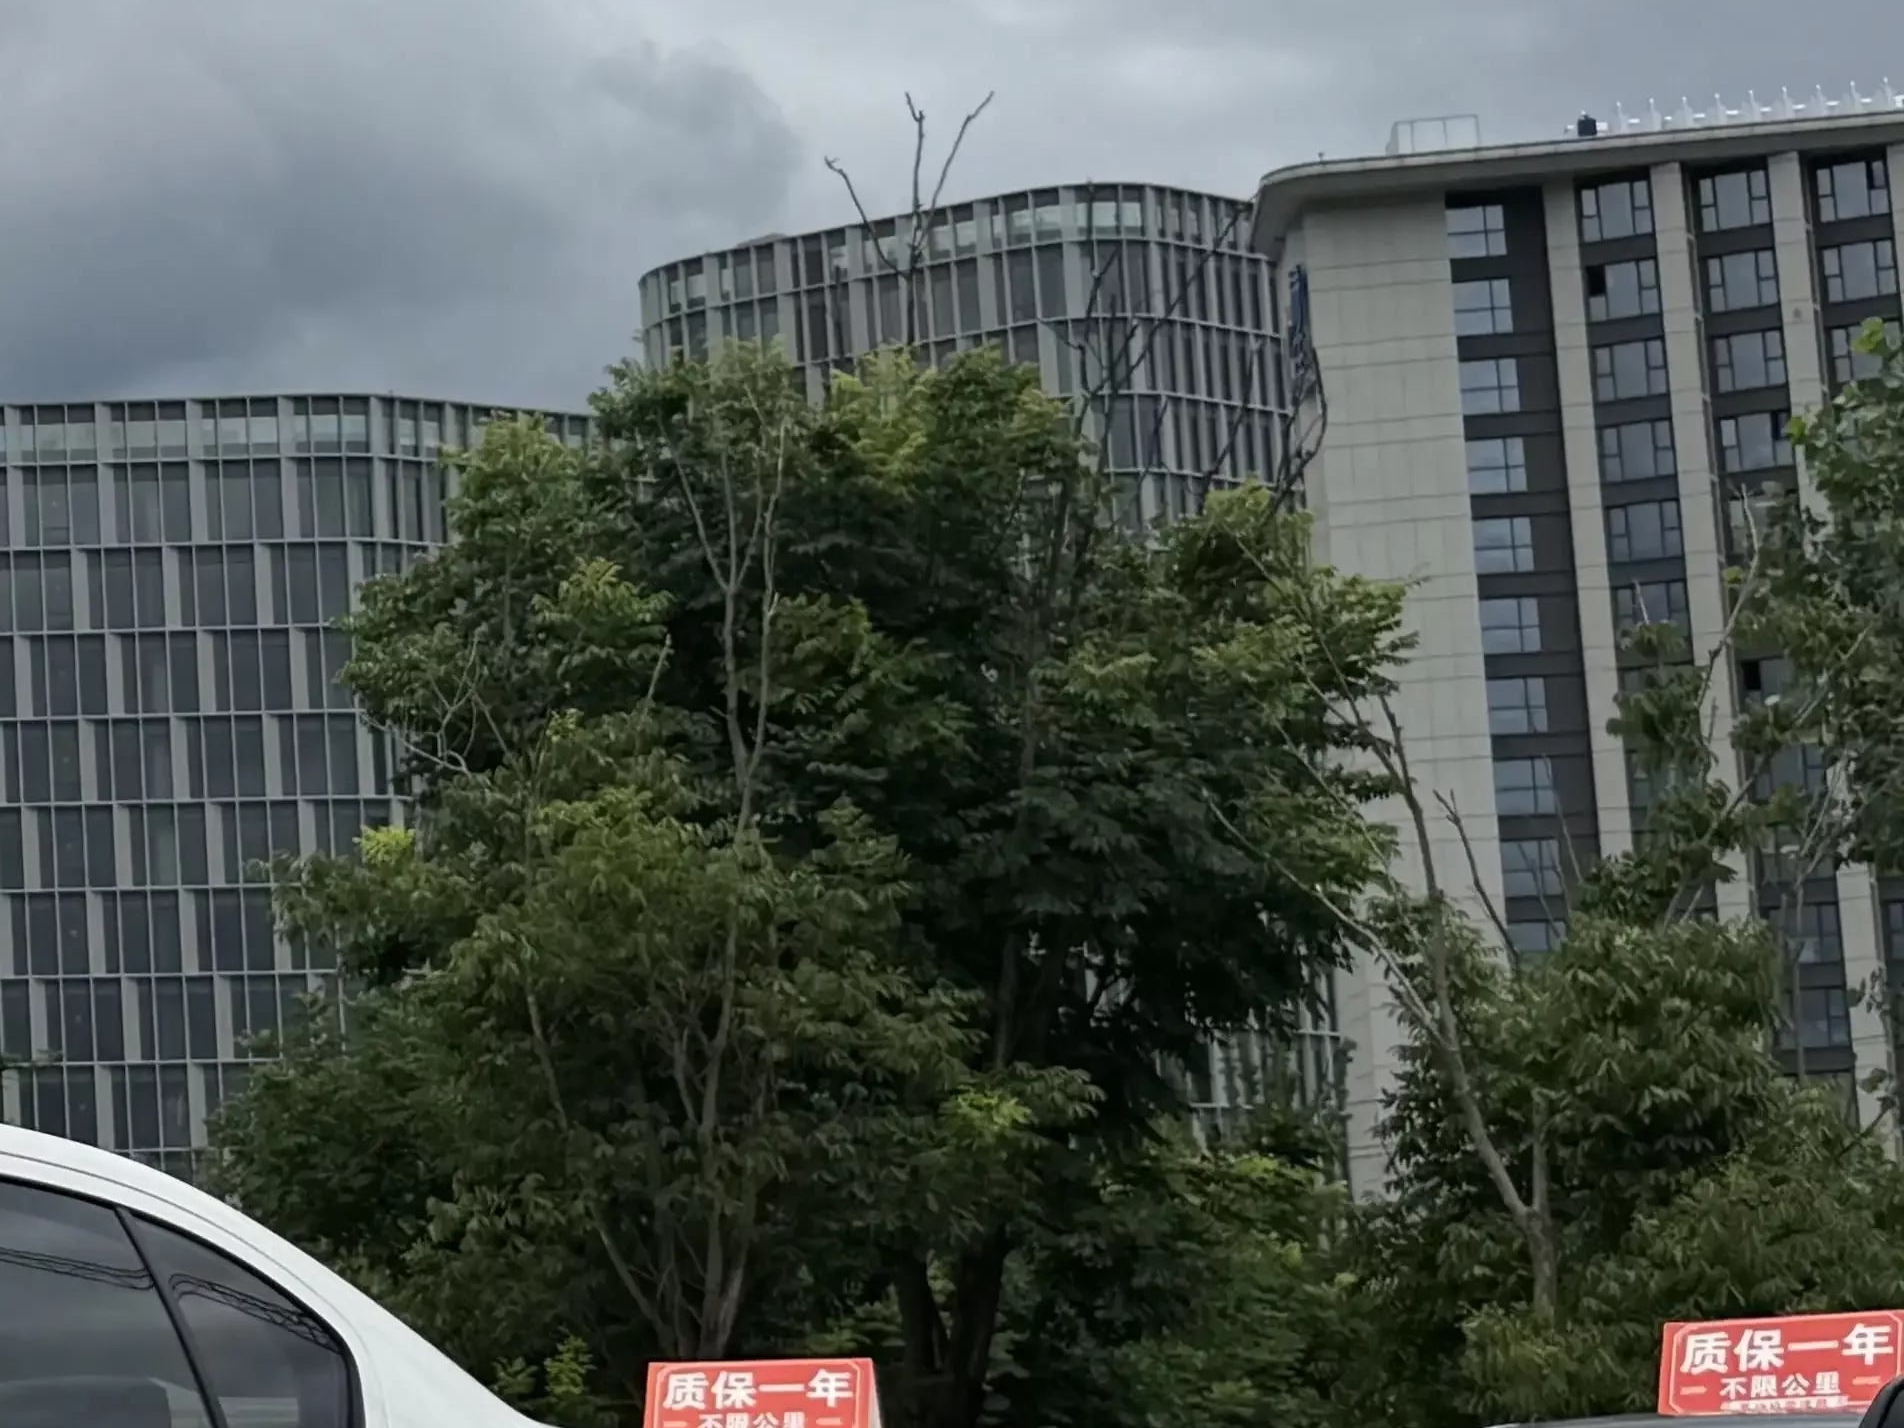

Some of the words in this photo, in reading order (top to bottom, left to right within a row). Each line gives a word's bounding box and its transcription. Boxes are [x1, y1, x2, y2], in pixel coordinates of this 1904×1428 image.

[1680, 1323, 1894, 1375] 质保一年
[662, 1368, 854, 1410] 质保一年
[1719, 1371, 1842, 1400] 不限公里
